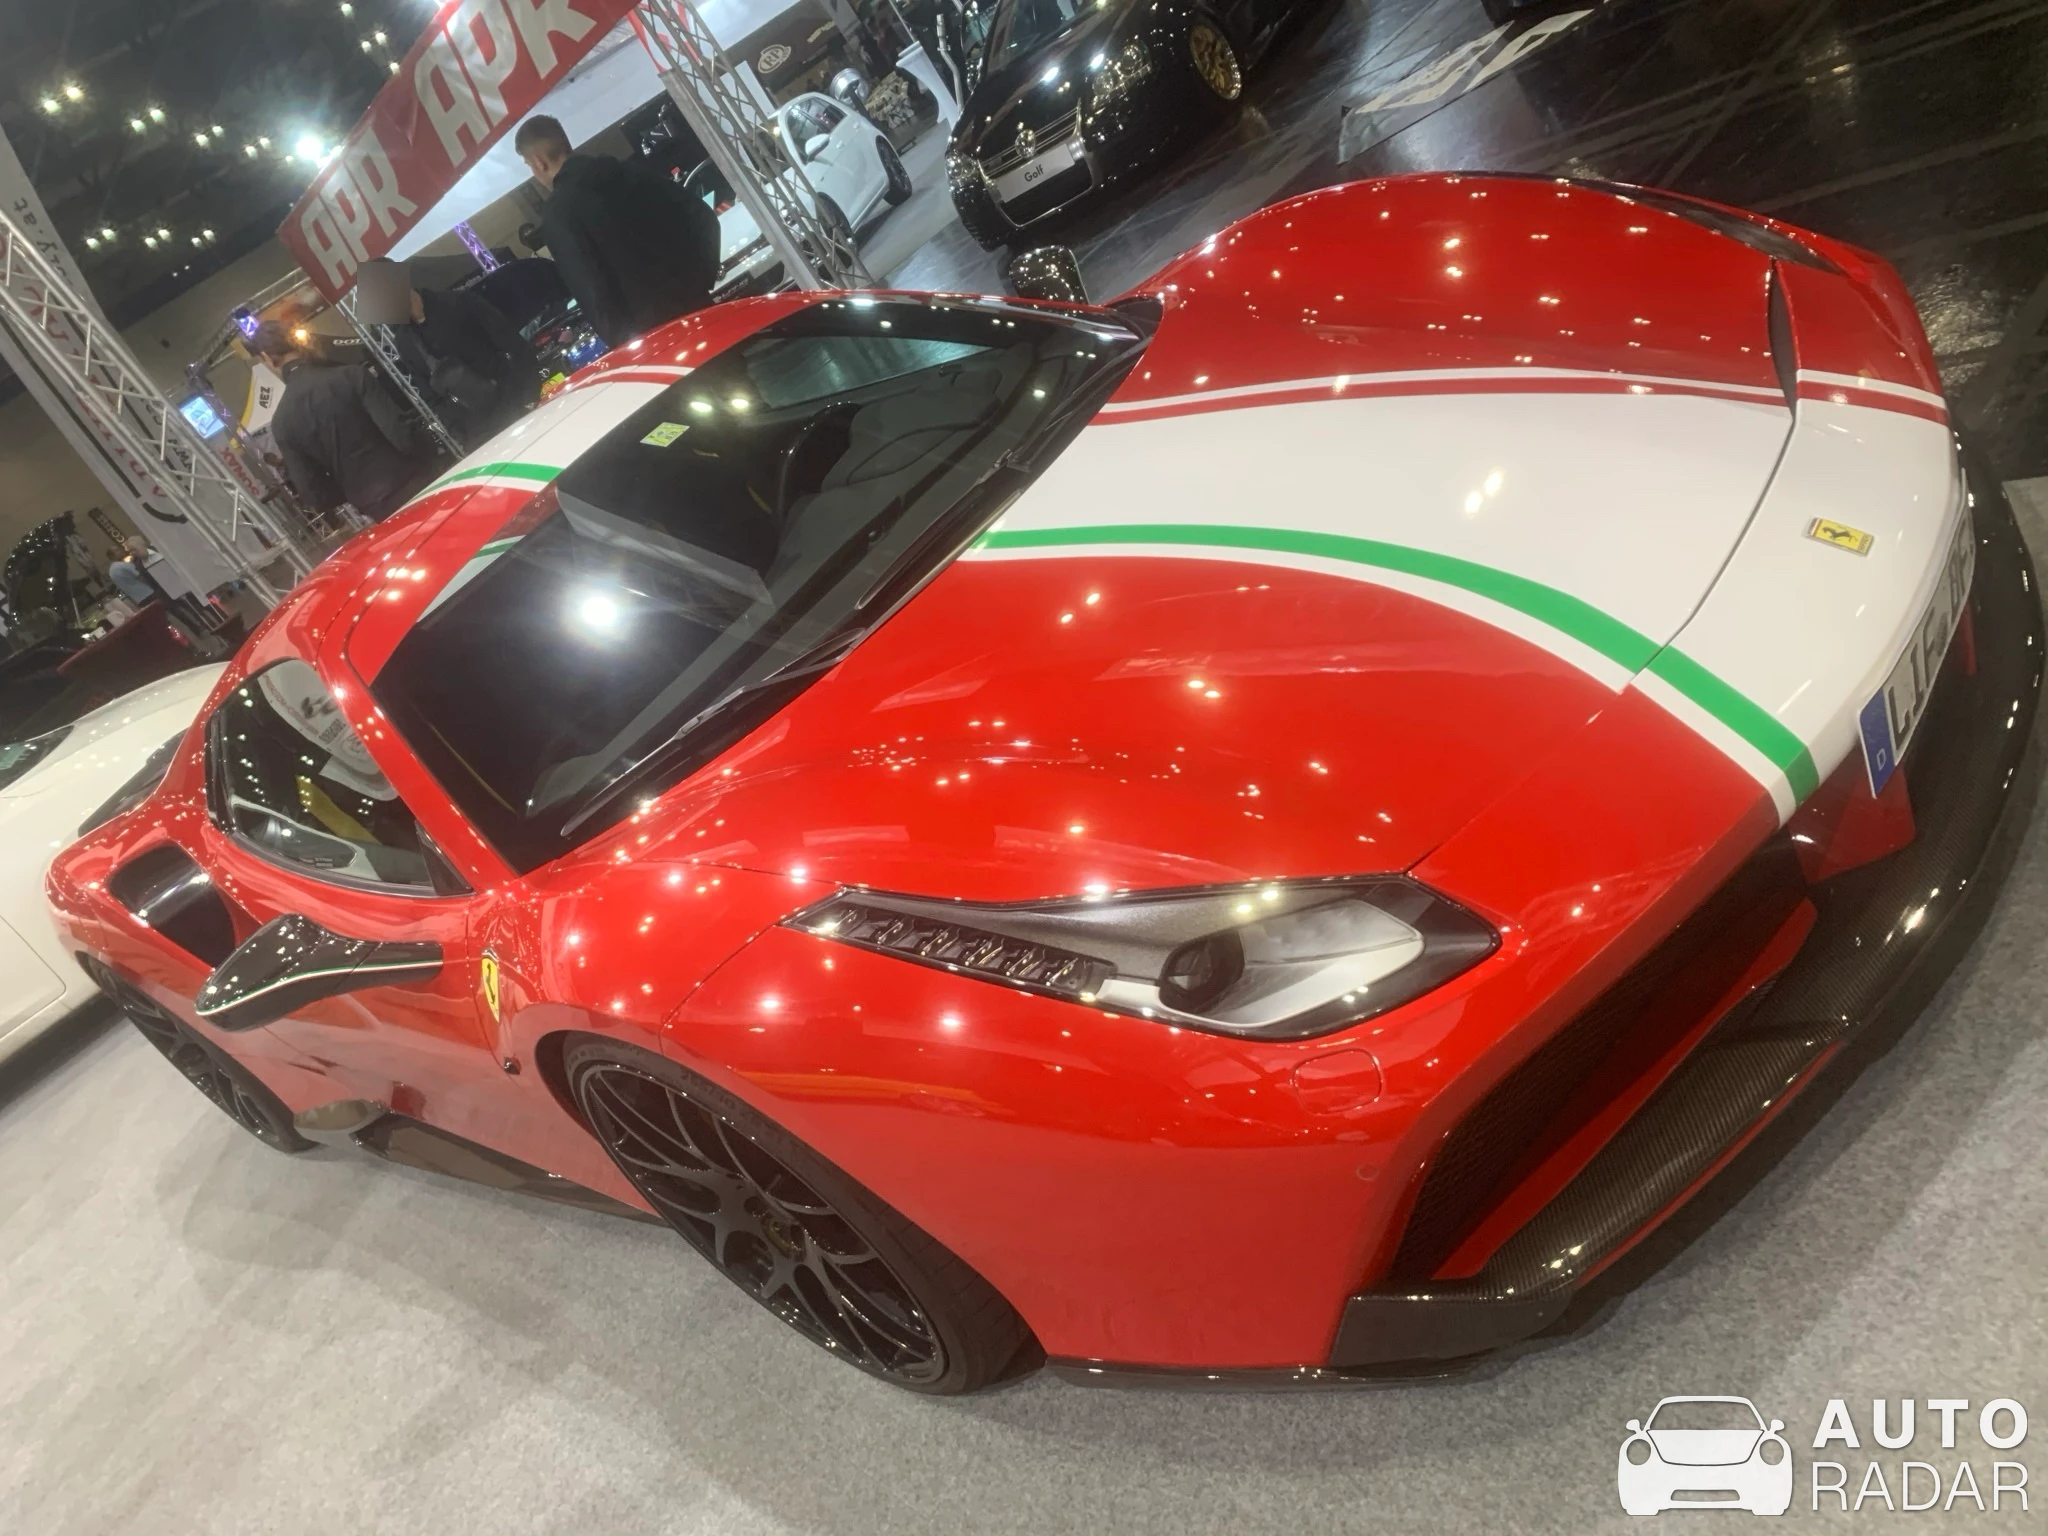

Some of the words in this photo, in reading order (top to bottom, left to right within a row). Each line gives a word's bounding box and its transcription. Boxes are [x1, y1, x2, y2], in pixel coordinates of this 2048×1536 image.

[1024, 163, 1044, 182] Golf
[301, 121, 419, 290] APR
[259, 386, 271, 409] AEZ
[1876, 748, 1887, 771] D
